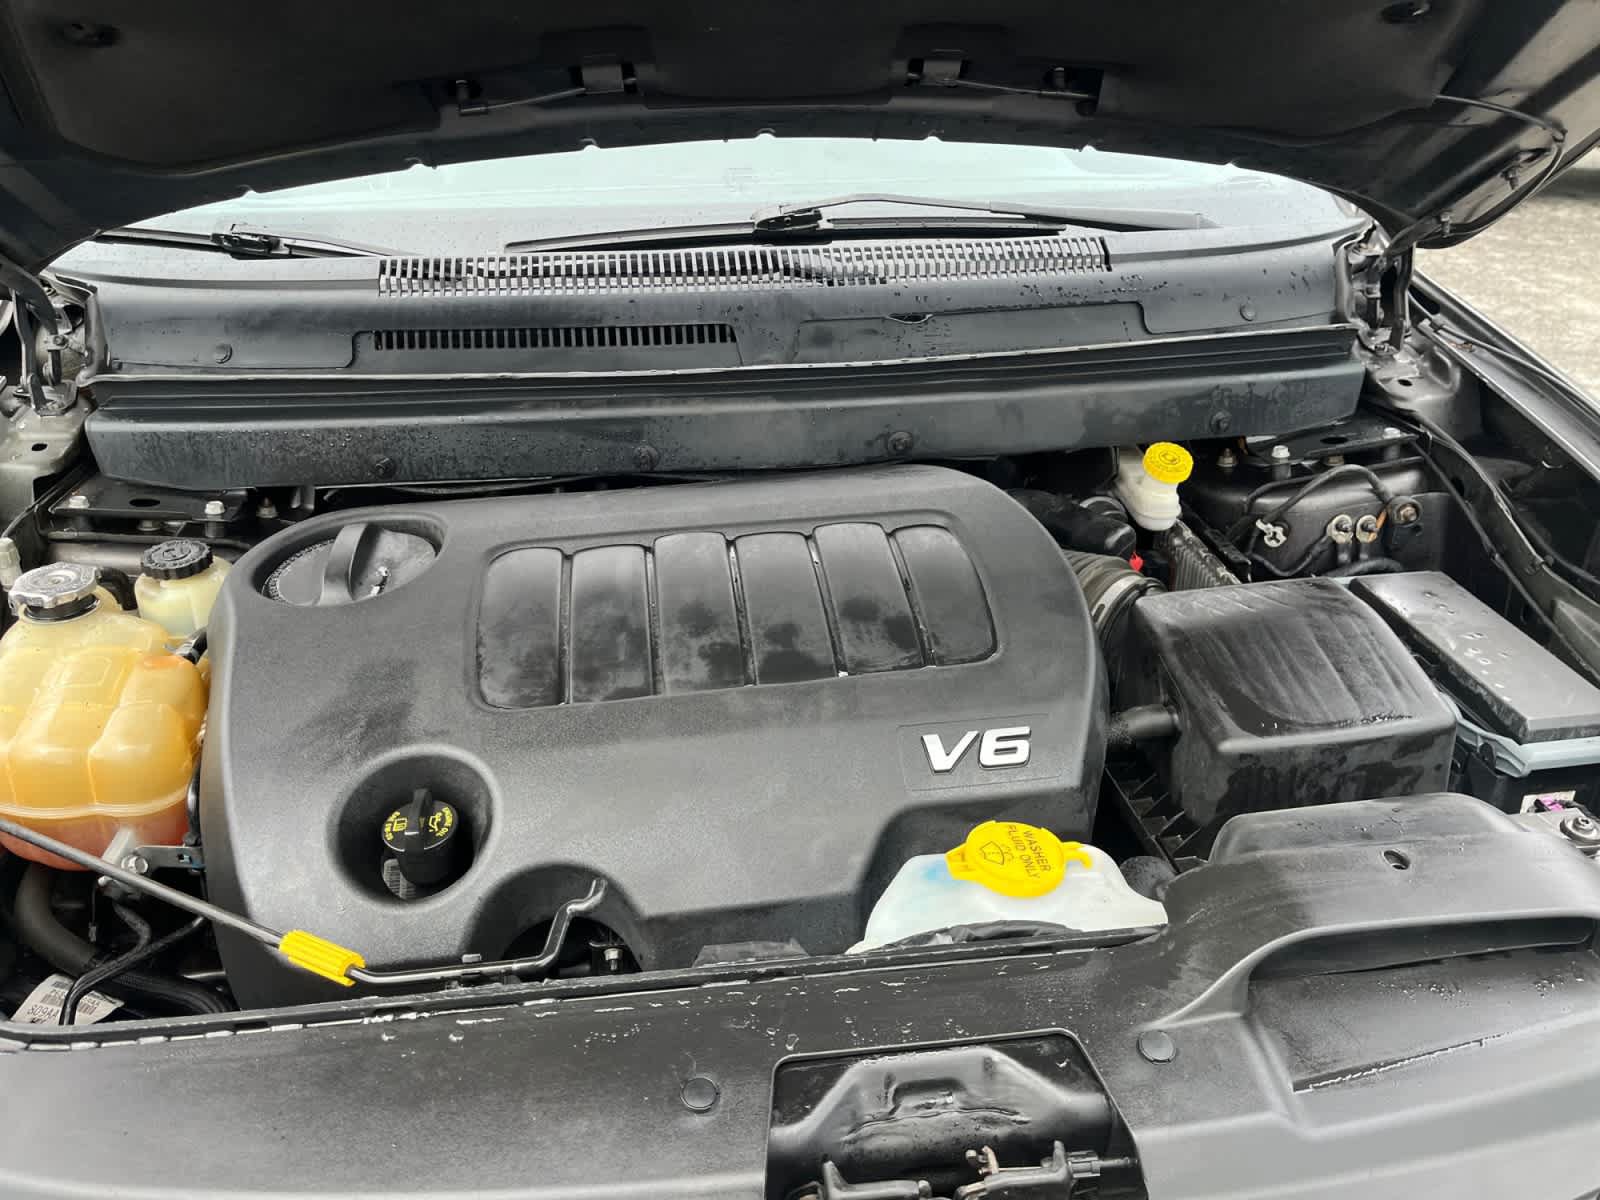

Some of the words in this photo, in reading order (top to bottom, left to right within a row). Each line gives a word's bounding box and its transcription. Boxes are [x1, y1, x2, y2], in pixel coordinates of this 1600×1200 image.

[921, 726, 1032, 774] V6
[1007, 824, 1027, 853] FLUID
[1019, 853, 1041, 879] ONLY
[1023, 830, 1052, 872] WASHER
